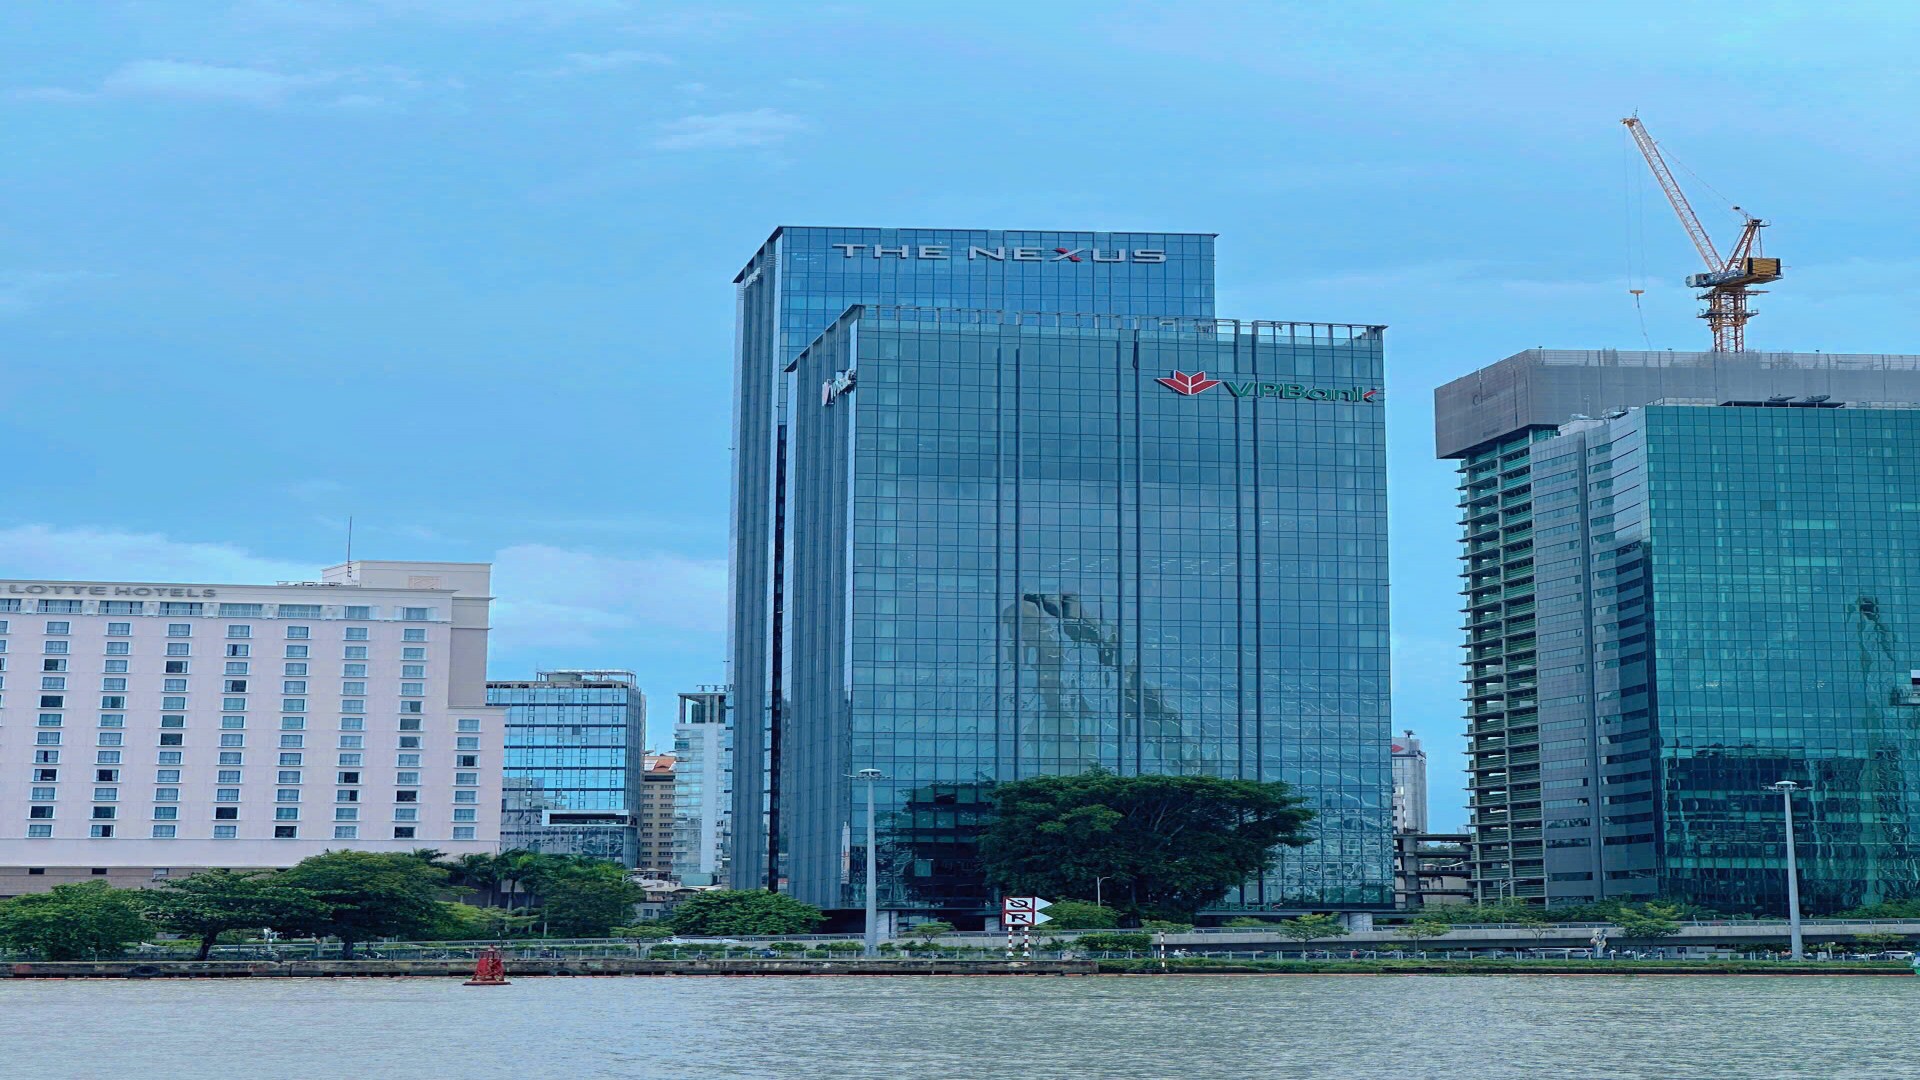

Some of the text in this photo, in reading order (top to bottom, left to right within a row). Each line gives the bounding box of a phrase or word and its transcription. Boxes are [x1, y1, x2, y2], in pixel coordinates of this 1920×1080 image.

[832, 243, 1167, 262] THE NEXUS
[1223, 381, 1377, 402] VPBank
[9, 585, 217, 598] LOTTE HOTELS
